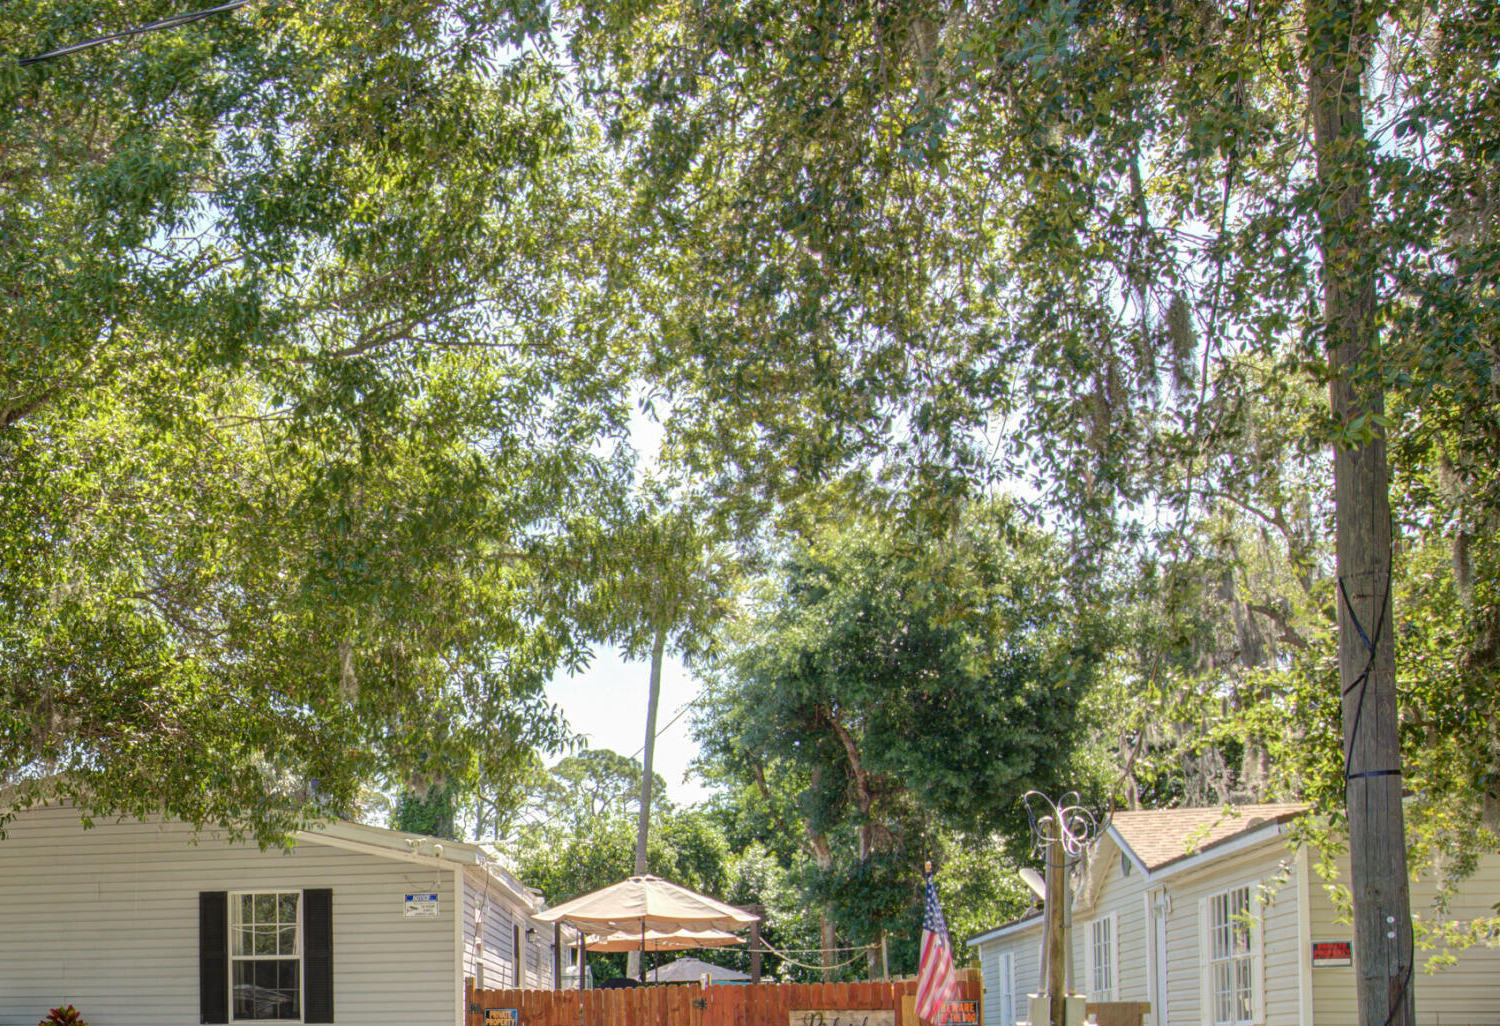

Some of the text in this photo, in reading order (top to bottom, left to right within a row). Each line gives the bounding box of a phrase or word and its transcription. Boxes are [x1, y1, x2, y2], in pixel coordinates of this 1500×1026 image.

[940, 1002, 975, 1012] BEWARE
[489, 1010, 512, 1019] PRIVATE
[486, 1018, 516, 1026] PROPERTY
